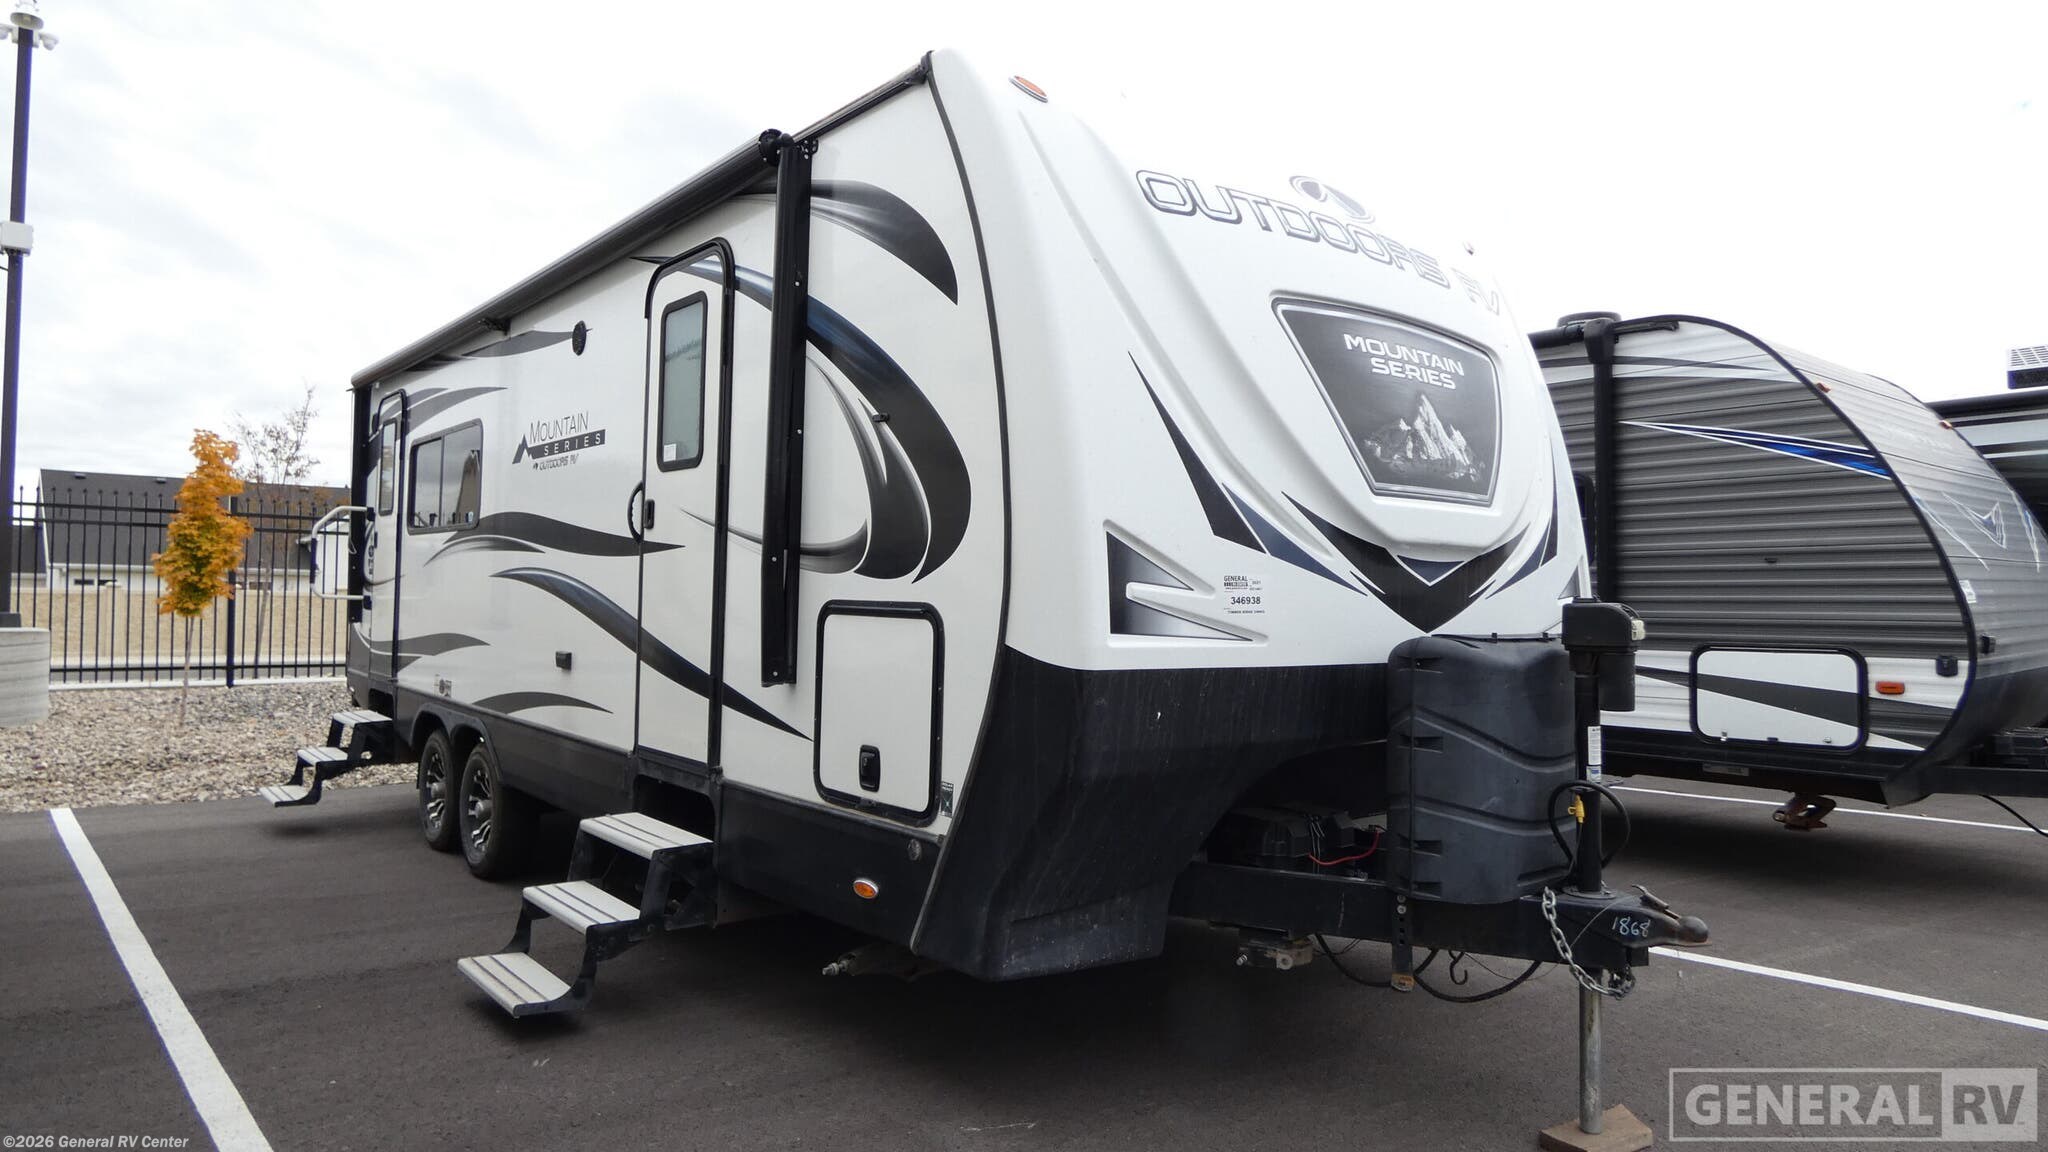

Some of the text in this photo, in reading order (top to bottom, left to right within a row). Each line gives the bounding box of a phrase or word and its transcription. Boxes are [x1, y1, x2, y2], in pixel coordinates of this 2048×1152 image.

[1136, 170, 1451, 290] OUTDOORS
[1343, 333, 1465, 376] MOUNTAIN
[1370, 357, 1457, 390] SERIES
[529, 411, 589, 444] MOUNTAIN
[543, 433, 601, 456] SERIES
[1611, 916, 1652, 938] 1868
